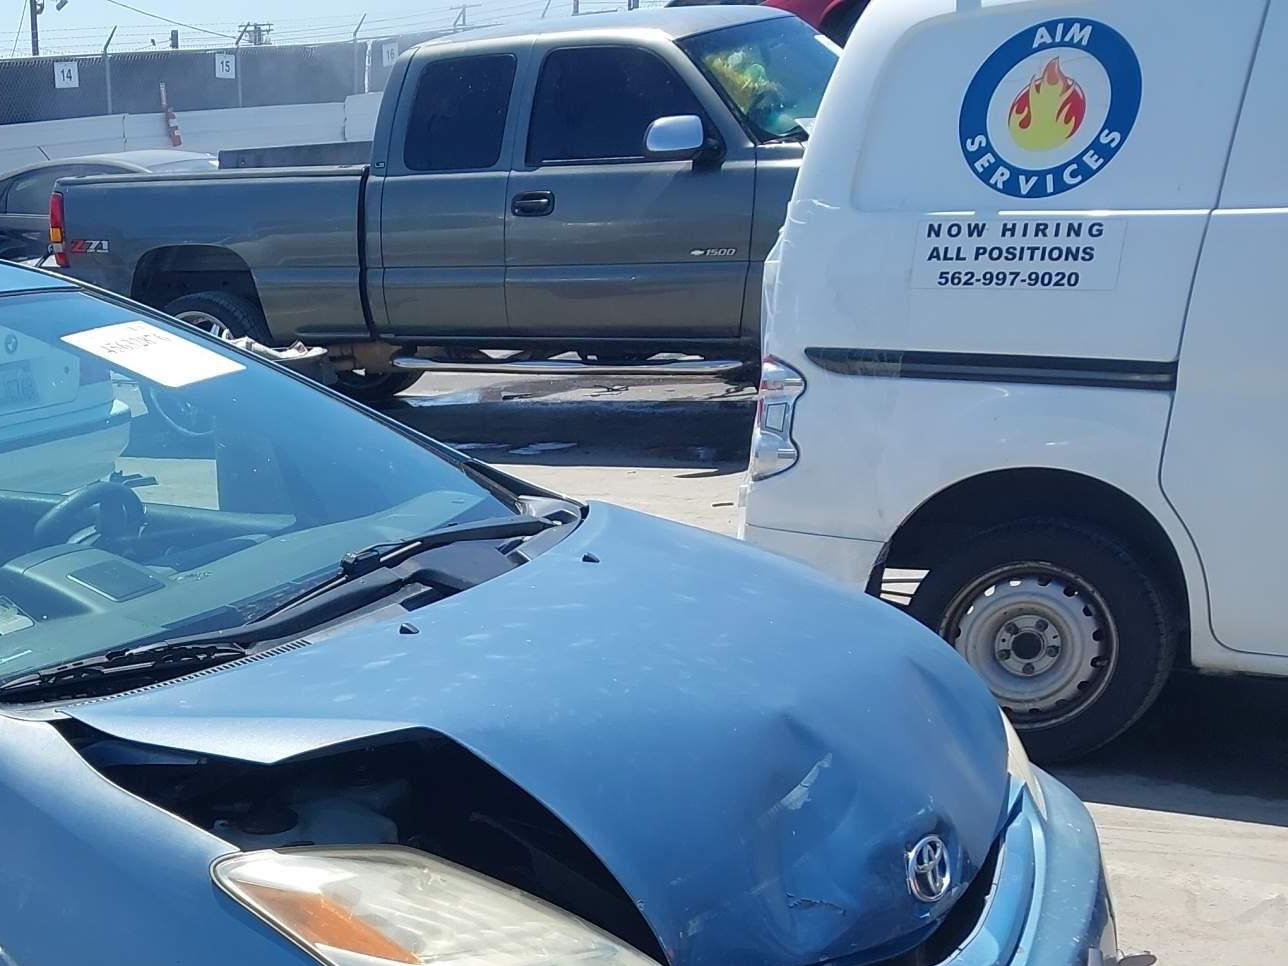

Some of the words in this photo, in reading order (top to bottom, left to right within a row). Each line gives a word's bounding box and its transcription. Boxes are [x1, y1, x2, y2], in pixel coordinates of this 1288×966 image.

[1032, 22, 1092, 48] AIM
[60, 67, 72, 82] 14
[219, 60, 231, 74] 15
[966, 129, 1121, 195] SERVICES
[927, 223, 986, 238] NOW
[1001, 222, 1104, 238] HIRING
[71, 240, 109, 253] Z71
[705, 248, 736, 256] 1500
[927, 246, 967, 262] ALL
[974, 246, 1095, 262] POSITIONS
[937, 271, 1080, 287] 562-997-9020
